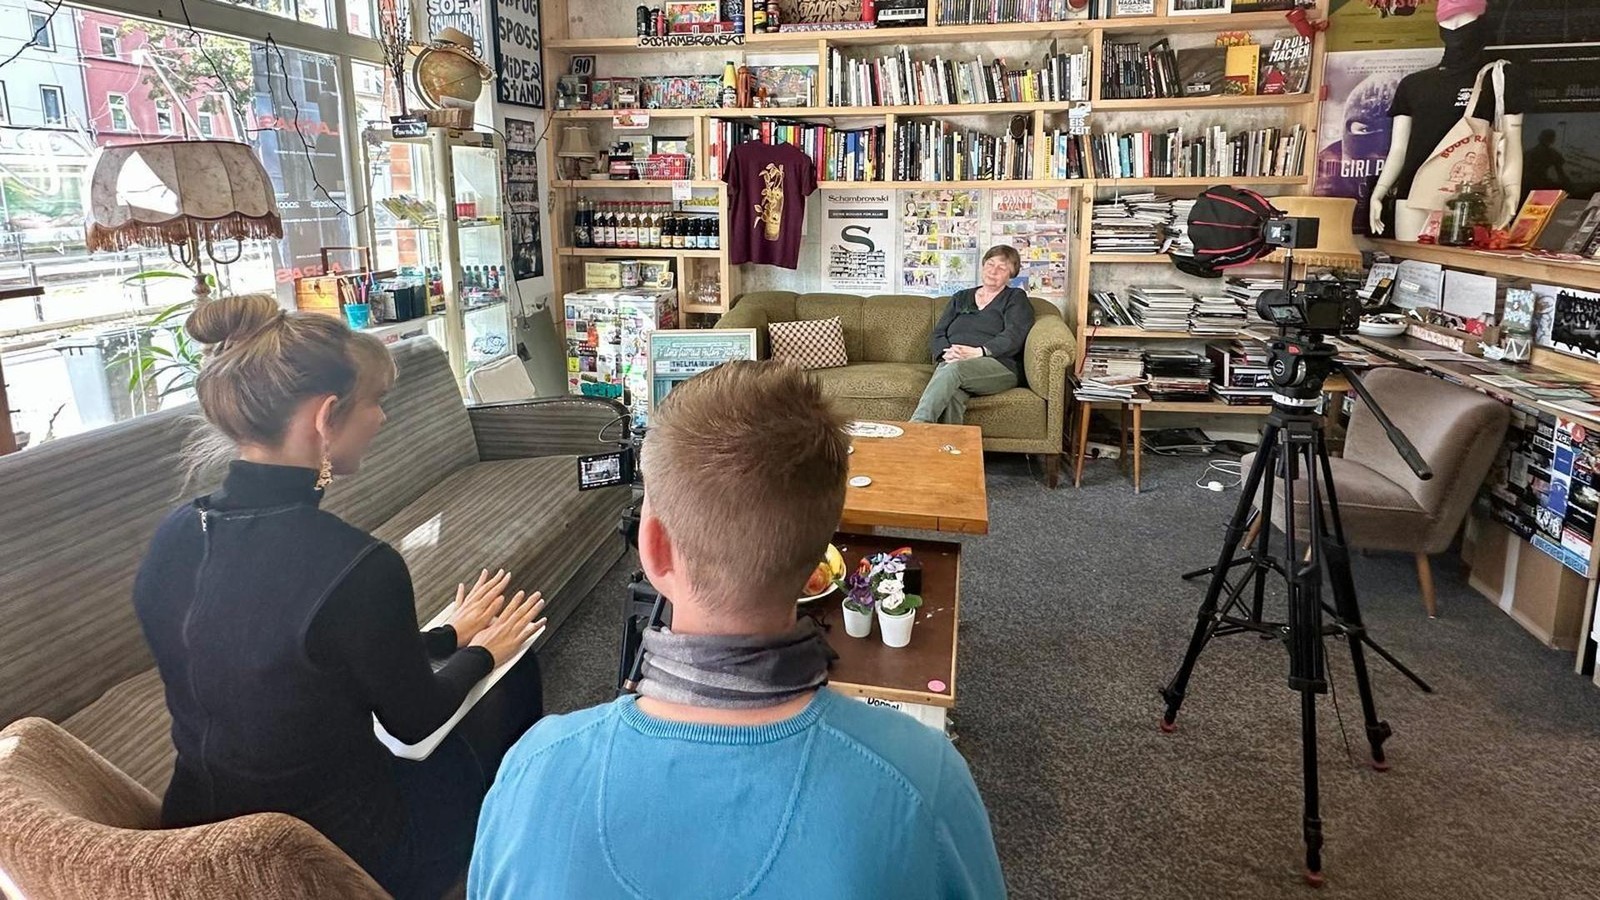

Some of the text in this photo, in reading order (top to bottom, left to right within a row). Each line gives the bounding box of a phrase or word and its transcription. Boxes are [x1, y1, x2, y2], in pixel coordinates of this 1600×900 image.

[1269, 43, 1310, 62] MACHEN
[575, 59, 591, 74] 90
[1070, 118, 1084, 126] EIS
[1069, 126, 1091, 134] ZEIT
[1341, 159, 1372, 177] GIRL
[1003, 196, 1033, 204] PAINT
[1534, 436, 1554, 452] LIEBE
